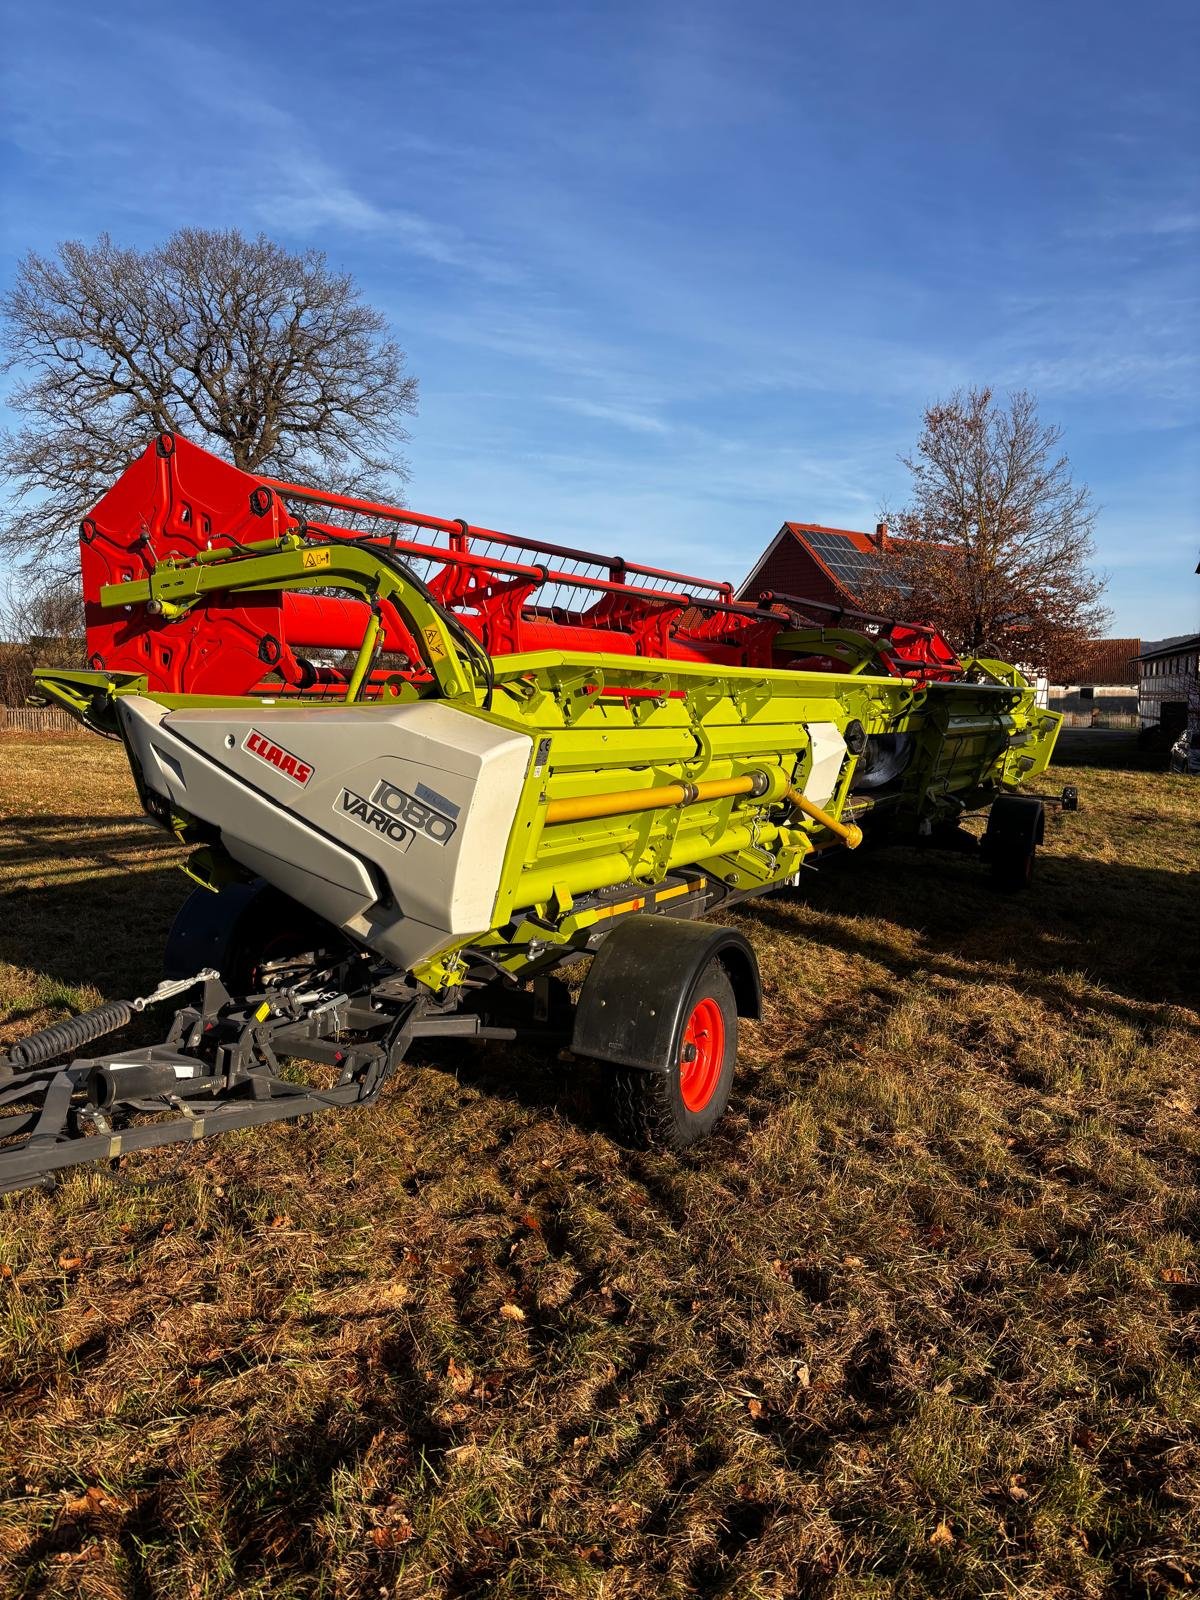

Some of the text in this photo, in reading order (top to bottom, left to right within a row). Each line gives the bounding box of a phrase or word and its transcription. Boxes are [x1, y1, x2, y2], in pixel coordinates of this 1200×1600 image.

[246, 733, 310, 783] CLAAS
[341, 791, 407, 843] VARIO
[373, 781, 449, 842] 1080
